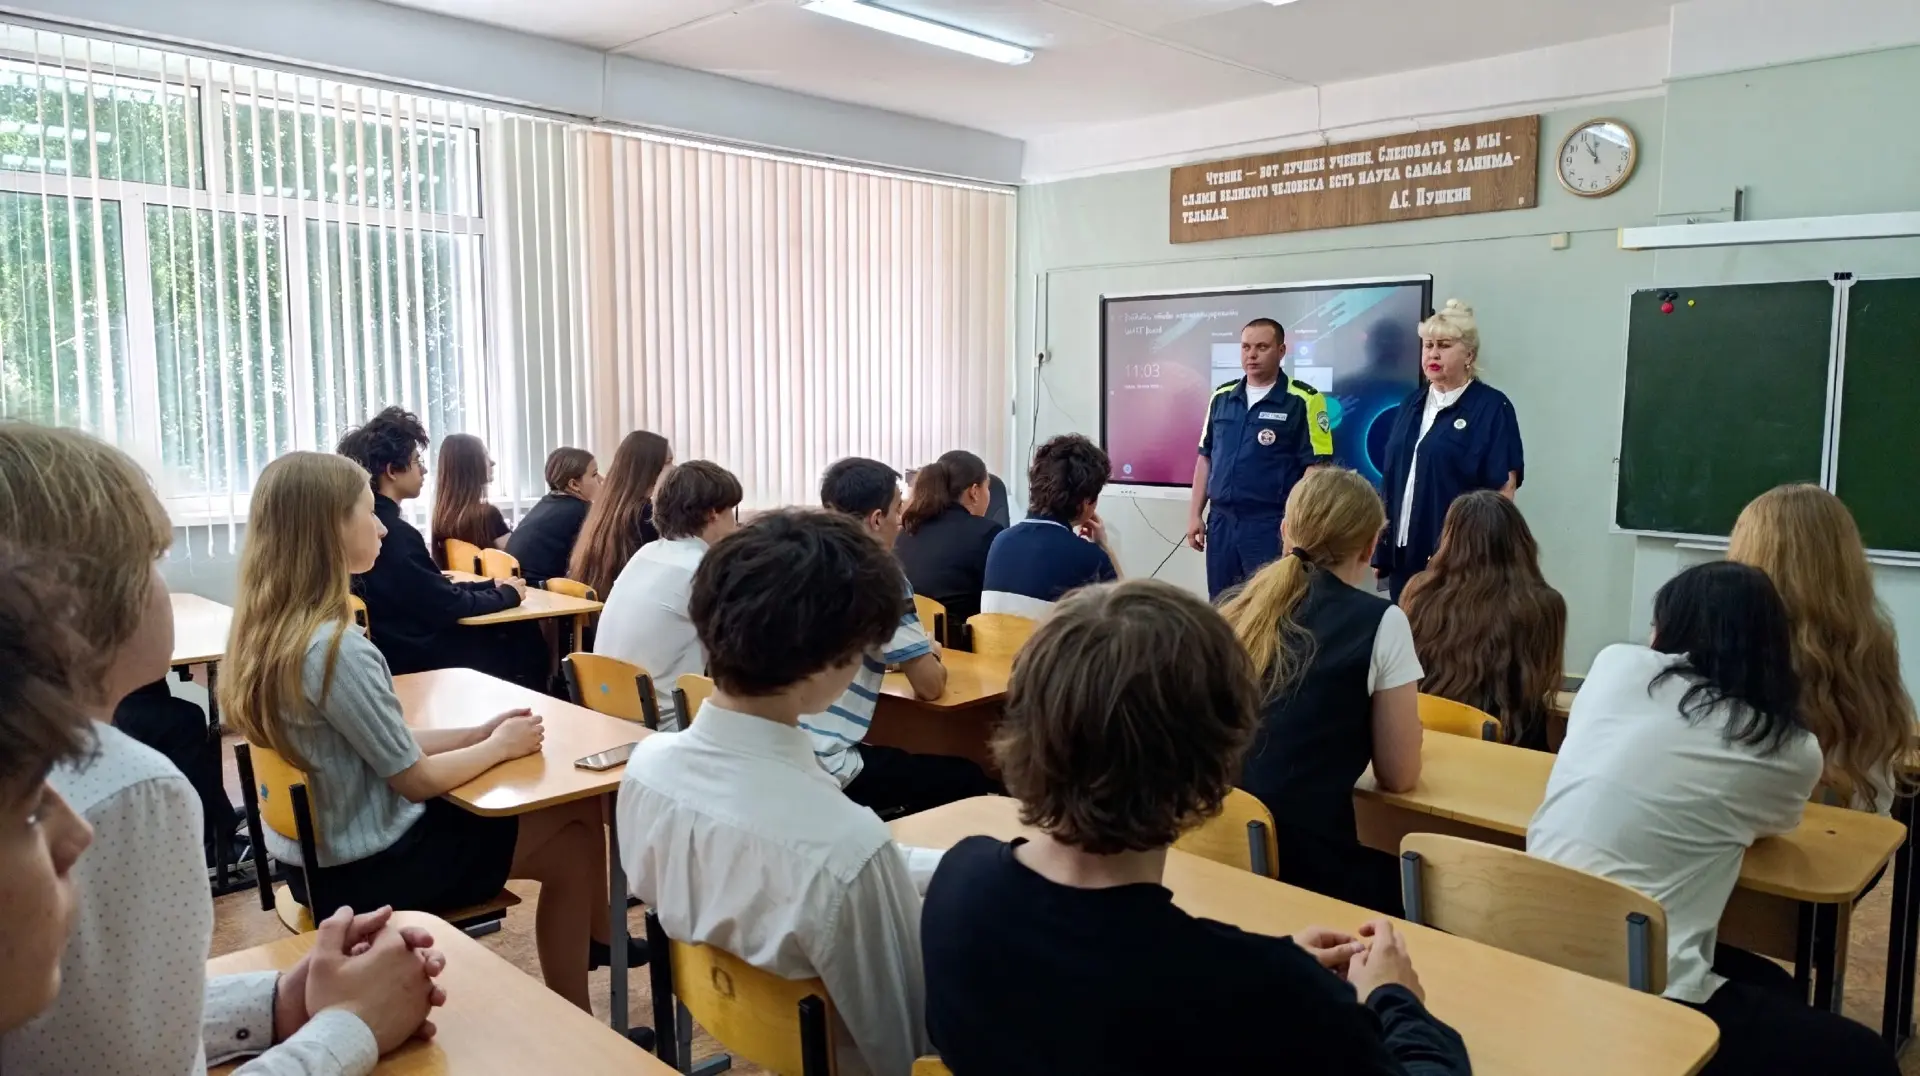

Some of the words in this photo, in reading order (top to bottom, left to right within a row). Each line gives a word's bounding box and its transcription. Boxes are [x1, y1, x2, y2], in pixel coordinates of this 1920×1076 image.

[1259, 164, 1279, 179] ВОТ
[1282, 158, 1325, 175] ЛУЧШЕЕ
[1329, 151, 1374, 169] УЧЕНИЕ.
[1453, 137, 1471, 152] ЗА
[1220, 184, 1268, 202] ВЕЛИКОГО
[1271, 177, 1324, 196] ЧЕЛОВЕКА
[1329, 173, 1355, 189] ЕСТЬ
[1358, 167, 1400, 185] НАУКА
[1405, 159, 1452, 178] САМАЯ
[1182, 207, 1229, 224] ТЕЛЬНАЯ.
[1124, 363, 1160, 378] 11:03
